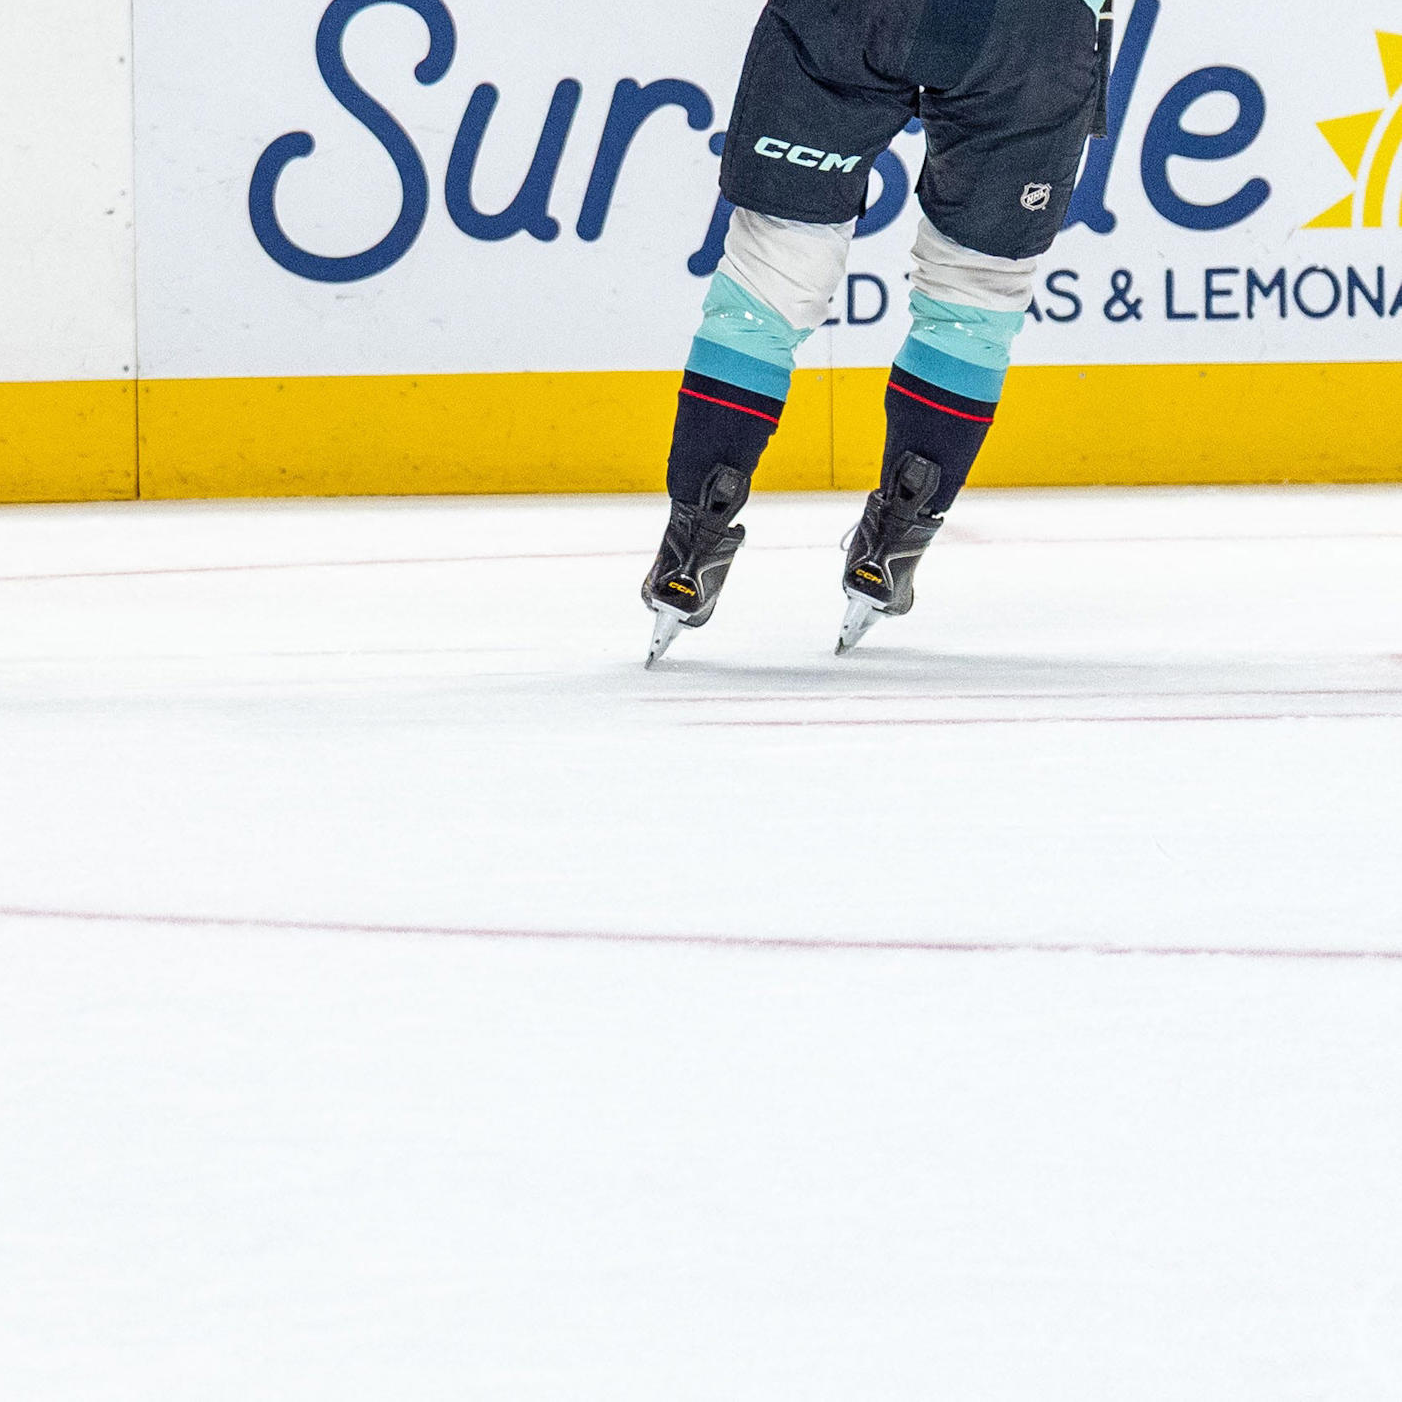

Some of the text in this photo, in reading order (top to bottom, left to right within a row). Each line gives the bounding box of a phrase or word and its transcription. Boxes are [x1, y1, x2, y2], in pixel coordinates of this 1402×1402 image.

[753, 135, 862, 173] CCM
[1103, 268, 1144, 323] &
[668, 580, 696, 598] CCM
[854, 568, 883, 585] CCM
